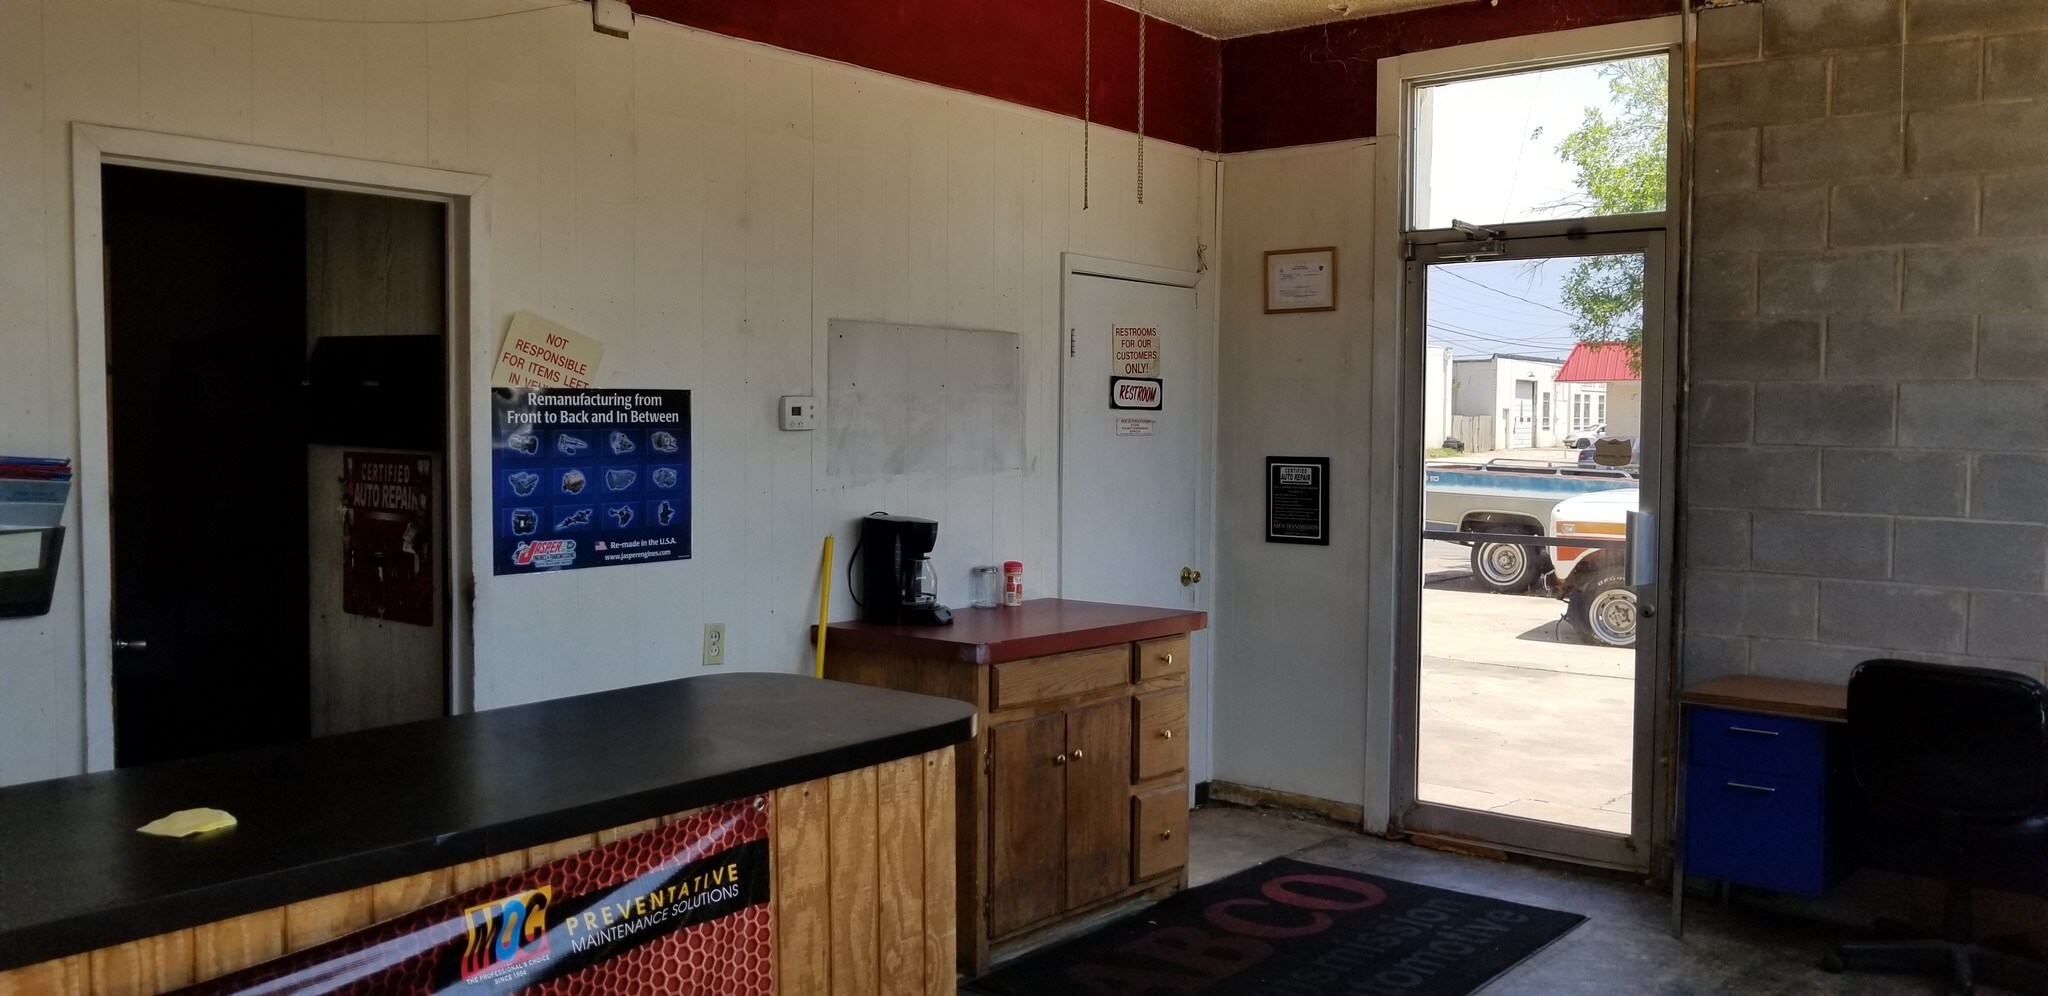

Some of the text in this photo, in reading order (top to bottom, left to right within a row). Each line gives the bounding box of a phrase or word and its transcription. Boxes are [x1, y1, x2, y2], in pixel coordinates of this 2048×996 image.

[1116, 328, 1157, 336] RESTROOMS
[546, 333, 569, 350] NOT
[1122, 340, 1151, 348] FOR OUR
[515, 339, 588, 375] RESPONSIBLE
[1117, 351, 1157, 360] CUSTOMERS
[502, 352, 590, 388] FOR ITEMS LEFT
[1125, 363, 1149, 374] ONLY!
[508, 372, 520, 386] IN
[528, 392, 662, 410] Remanufacturing from
[1120, 385, 1157, 403] RESTROOM
[507, 410, 679, 424] Front to Back and In Between
[361, 462, 410, 483] CERTIFIED
[353, 482, 380, 507] AUTO
[518, 540, 563, 564] JASPER
[610, 540, 640, 549] Re-made
[648, 538, 659, 546] the
[605, 549, 671, 560] www.jasperengines.com
[566, 863, 739, 936] PREVENTATIVE
[571, 884, 739, 954] MAINTENANCE SOLUTIONS
[464, 891, 549, 975] MOC
[466, 954, 550, 985] THE PROFESSIONAL'S CHOICE
[494, 974, 513, 985] SINCE
